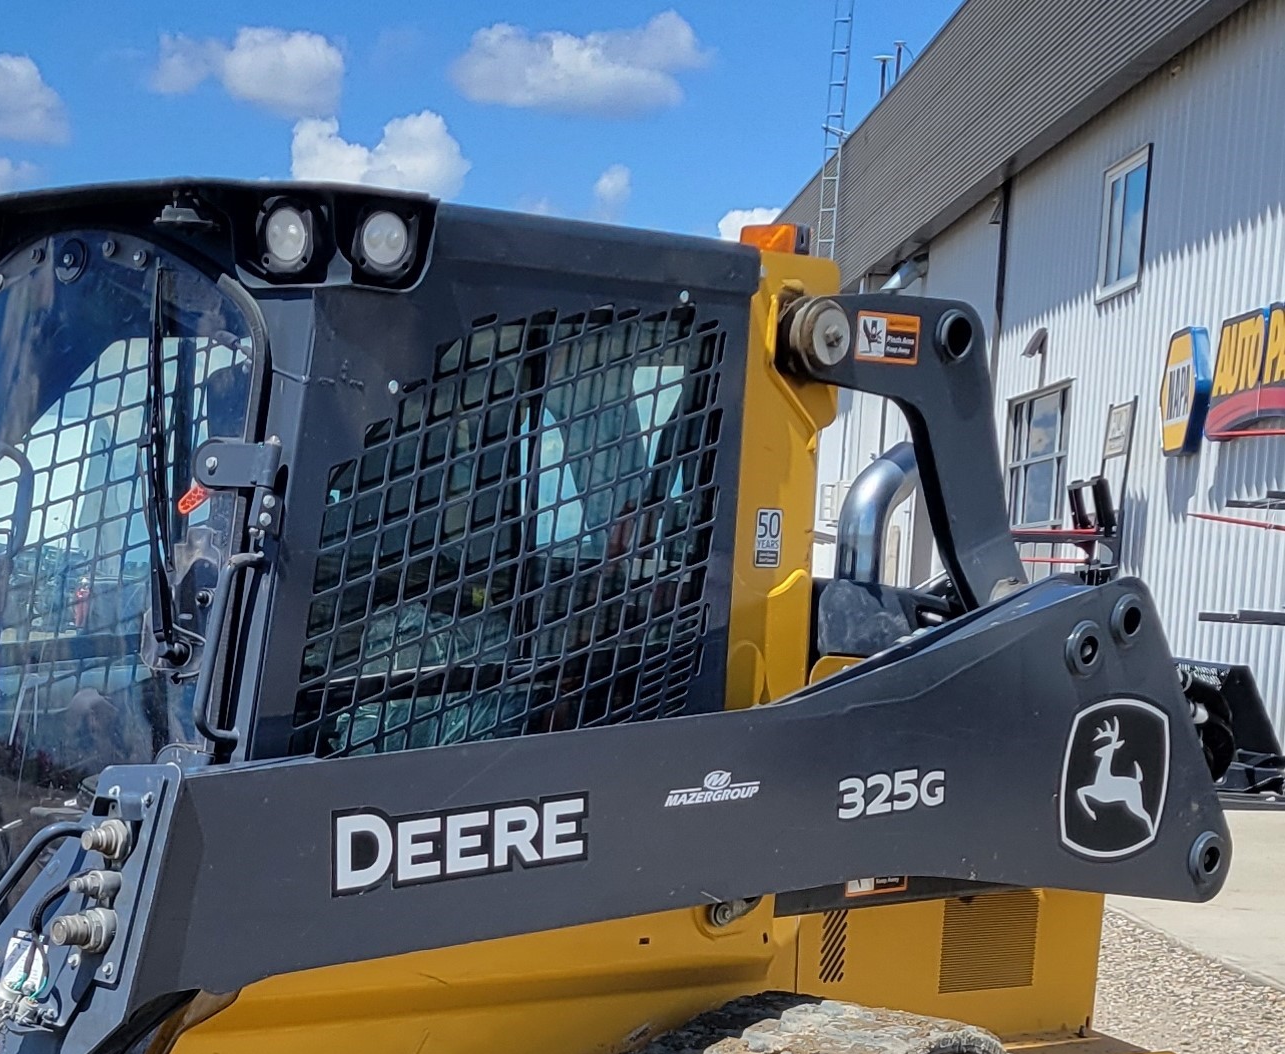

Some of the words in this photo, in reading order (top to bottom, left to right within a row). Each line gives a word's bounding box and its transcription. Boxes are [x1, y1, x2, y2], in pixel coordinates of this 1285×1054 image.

[1212, 313, 1265, 398] AUTO
[1167, 364, 1191, 421] NAPA
[757, 511, 781, 538] 50
[757, 540, 780, 550] YEARS
[664, 786, 760, 807] MAZERGROUP
[838, 769, 925, 820] 325G
[336, 798, 585, 890] DEERE
